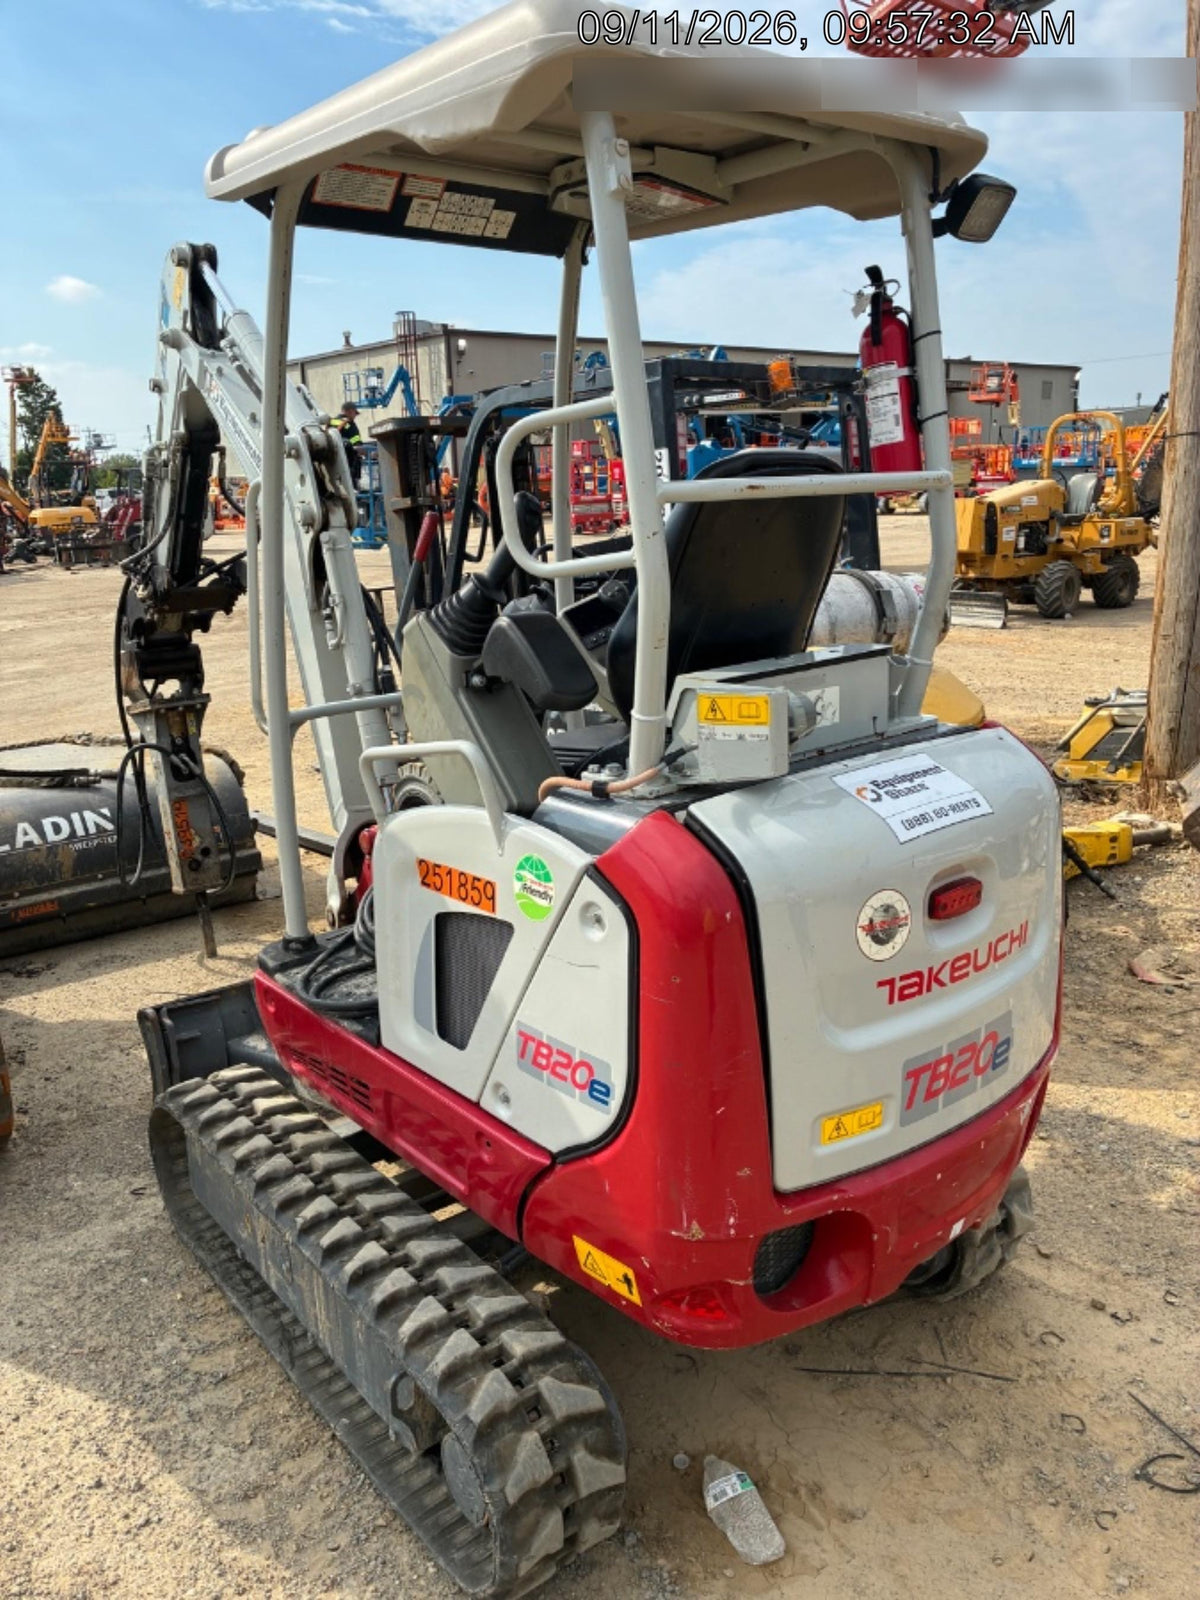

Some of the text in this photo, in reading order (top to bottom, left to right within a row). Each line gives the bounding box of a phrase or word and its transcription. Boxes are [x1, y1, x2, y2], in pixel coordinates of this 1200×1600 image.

[870, 765, 945, 789] Equipment
[884, 783, 929, 799] Share
[901, 812, 934, 831] (888)
[418, 858, 496, 913] 251859
[517, 1029, 611, 1107] TB20e
[904, 1031, 1011, 1112] TB20e
